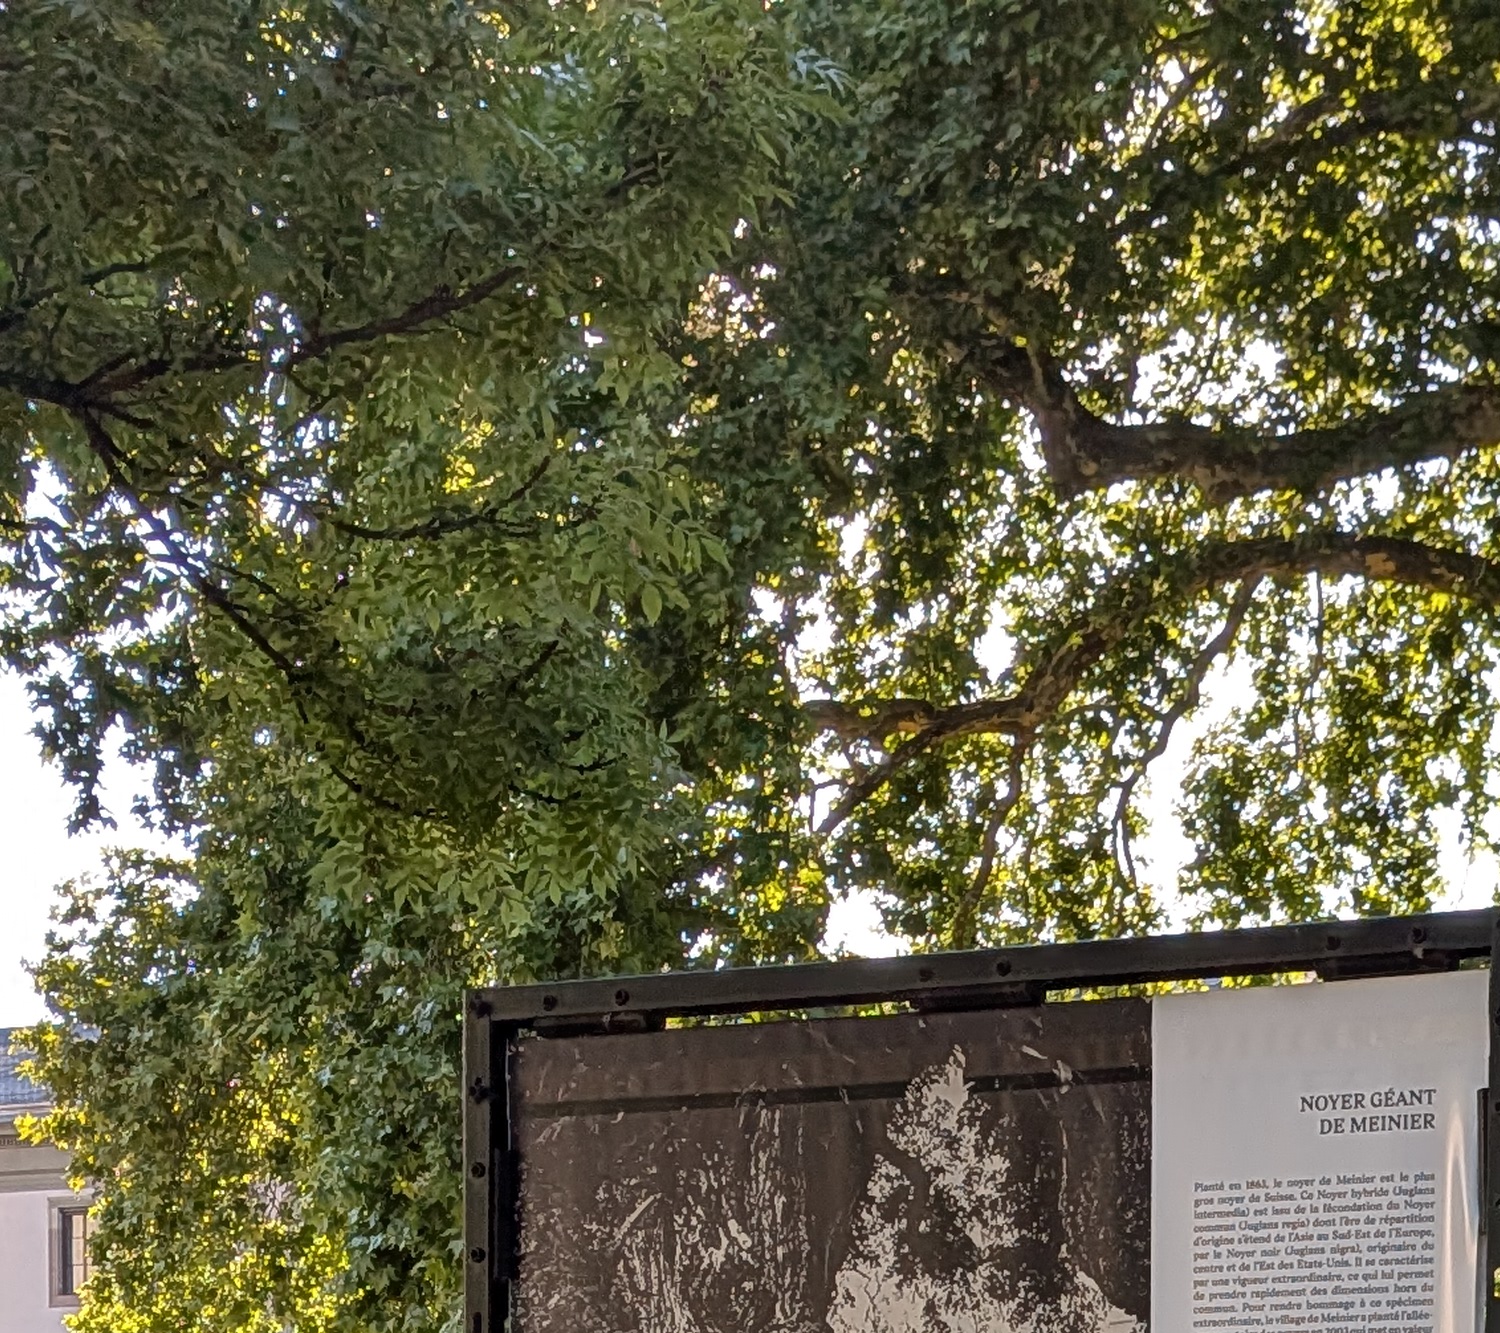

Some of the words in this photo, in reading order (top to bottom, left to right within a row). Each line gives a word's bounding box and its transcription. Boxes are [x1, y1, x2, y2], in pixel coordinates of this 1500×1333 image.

[1300, 1093, 1366, 1112] NOYER
[1370, 1088, 1437, 1108] GÉANT
[1320, 1117, 1345, 1135] DE
[1350, 1113, 1436, 1134] MEINIER
[1194, 1180, 1224, 1192] Planté
[1229, 1181, 1241, 1190] en
[1273, 1177, 1282, 1188] le
[1287, 1178, 1315, 1190] noyer
[1319, 1175, 1331, 1186] de
[1336, 1173, 1376, 1185] Meinier
[1380, 1172, 1395, 1183] est
[1400, 1171, 1409, 1182] le
[1414, 1170, 1435, 1184] plus
[1194, 1196, 1214, 1208] gros
[1217, 1195, 1246, 1207] noyer
[1248, 1192, 1261, 1203] de
[1300, 1190, 1314, 1201] Ce
[1317, 1188, 1349, 1203] Noyer
[1351, 1186, 1389, 1201] hybride
[1194, 1206, 1250, 1222] intermedia)
[1253, 1205, 1268, 1216] est
[1271, 1204, 1291, 1216] issu
[1294, 1203, 1307, 1214] de
[1310, 1203, 1319, 1214] la
[1323, 1199, 1383, 1213] fécondation
[1386, 1199, 1402, 1210] du
[1404, 1197, 1435, 1212] Noyer
[1193, 1223, 1236, 1234] commun
[1282, 1217, 1310, 1232] regia)
[1312, 1216, 1336, 1228] dont
[1363, 1214, 1376, 1225] de
[1379, 1211, 1435, 1227] répartition
[1193, 1234, 1235, 1249] d'origine
[1274, 1232, 1286, 1243] de
[1288, 1230, 1314, 1242] l'Asie
[1316, 1232, 1329, 1241] au
[1332, 1228, 1371, 1240] Sud-Est
[1373, 1227, 1386, 1238] de
[1193, 1251, 1210, 1263] par
[1213, 1248, 1222, 1259] le
[1226, 1247, 1257, 1261] Noyer
[1260, 1245, 1281, 1257] noir
[1366, 1239, 1419, 1255] originaire
[1421, 1239, 1435, 1250] du
[1193, 1262, 1224, 1274] centre
[1226, 1261, 1236, 1272] et
[1238, 1260, 1251, 1272] de
[1253, 1259, 1275, 1271] l'Est
[1277, 1259, 1294, 1270] des
[1354, 1256, 1363, 1267] Il
[1365, 1258, 1376, 1266] se
[1378, 1253, 1435, 1266] caractérise
[1193, 1278, 1209, 1289] par
[1211, 1277, 1230, 1286] une
[1232, 1273, 1269, 1288] vigueur
[1347, 1272, 1359, 1281] ce
[1361, 1269, 1378, 1283] qui
[1381, 1268, 1395, 1280] lui
[1397, 1267, 1435, 1281] permet
[1193, 1289, 1205, 1301] de
[1209, 1288, 1247, 1302] prendre
[1250, 1285, 1308, 1301] rapidement
[1309, 1285, 1328, 1296] des
[1331, 1282, 1392, 1295] dimensions
[1393, 1281, 1417, 1293] hors
[1421, 1281, 1435, 1292] du
[1242, 1301, 1266, 1312] Pour
[1269, 1299, 1302, 1311] rendre
[1306, 1297, 1356, 1312] hommage
[1369, 1299, 1382, 1308] ce
[1385, 1294, 1435, 1309] spécimen
[1265, 1314, 1274, 1325] le
[1275, 1313, 1306, 1327] village
[1307, 1312, 1319, 1323] de
[1320, 1311, 1359, 1323] Meinier
[1368, 1309, 1400, 1323] planté
[1388, 1325, 1401, 1333] en
[1402, 1322, 1435, 1333] valeur
